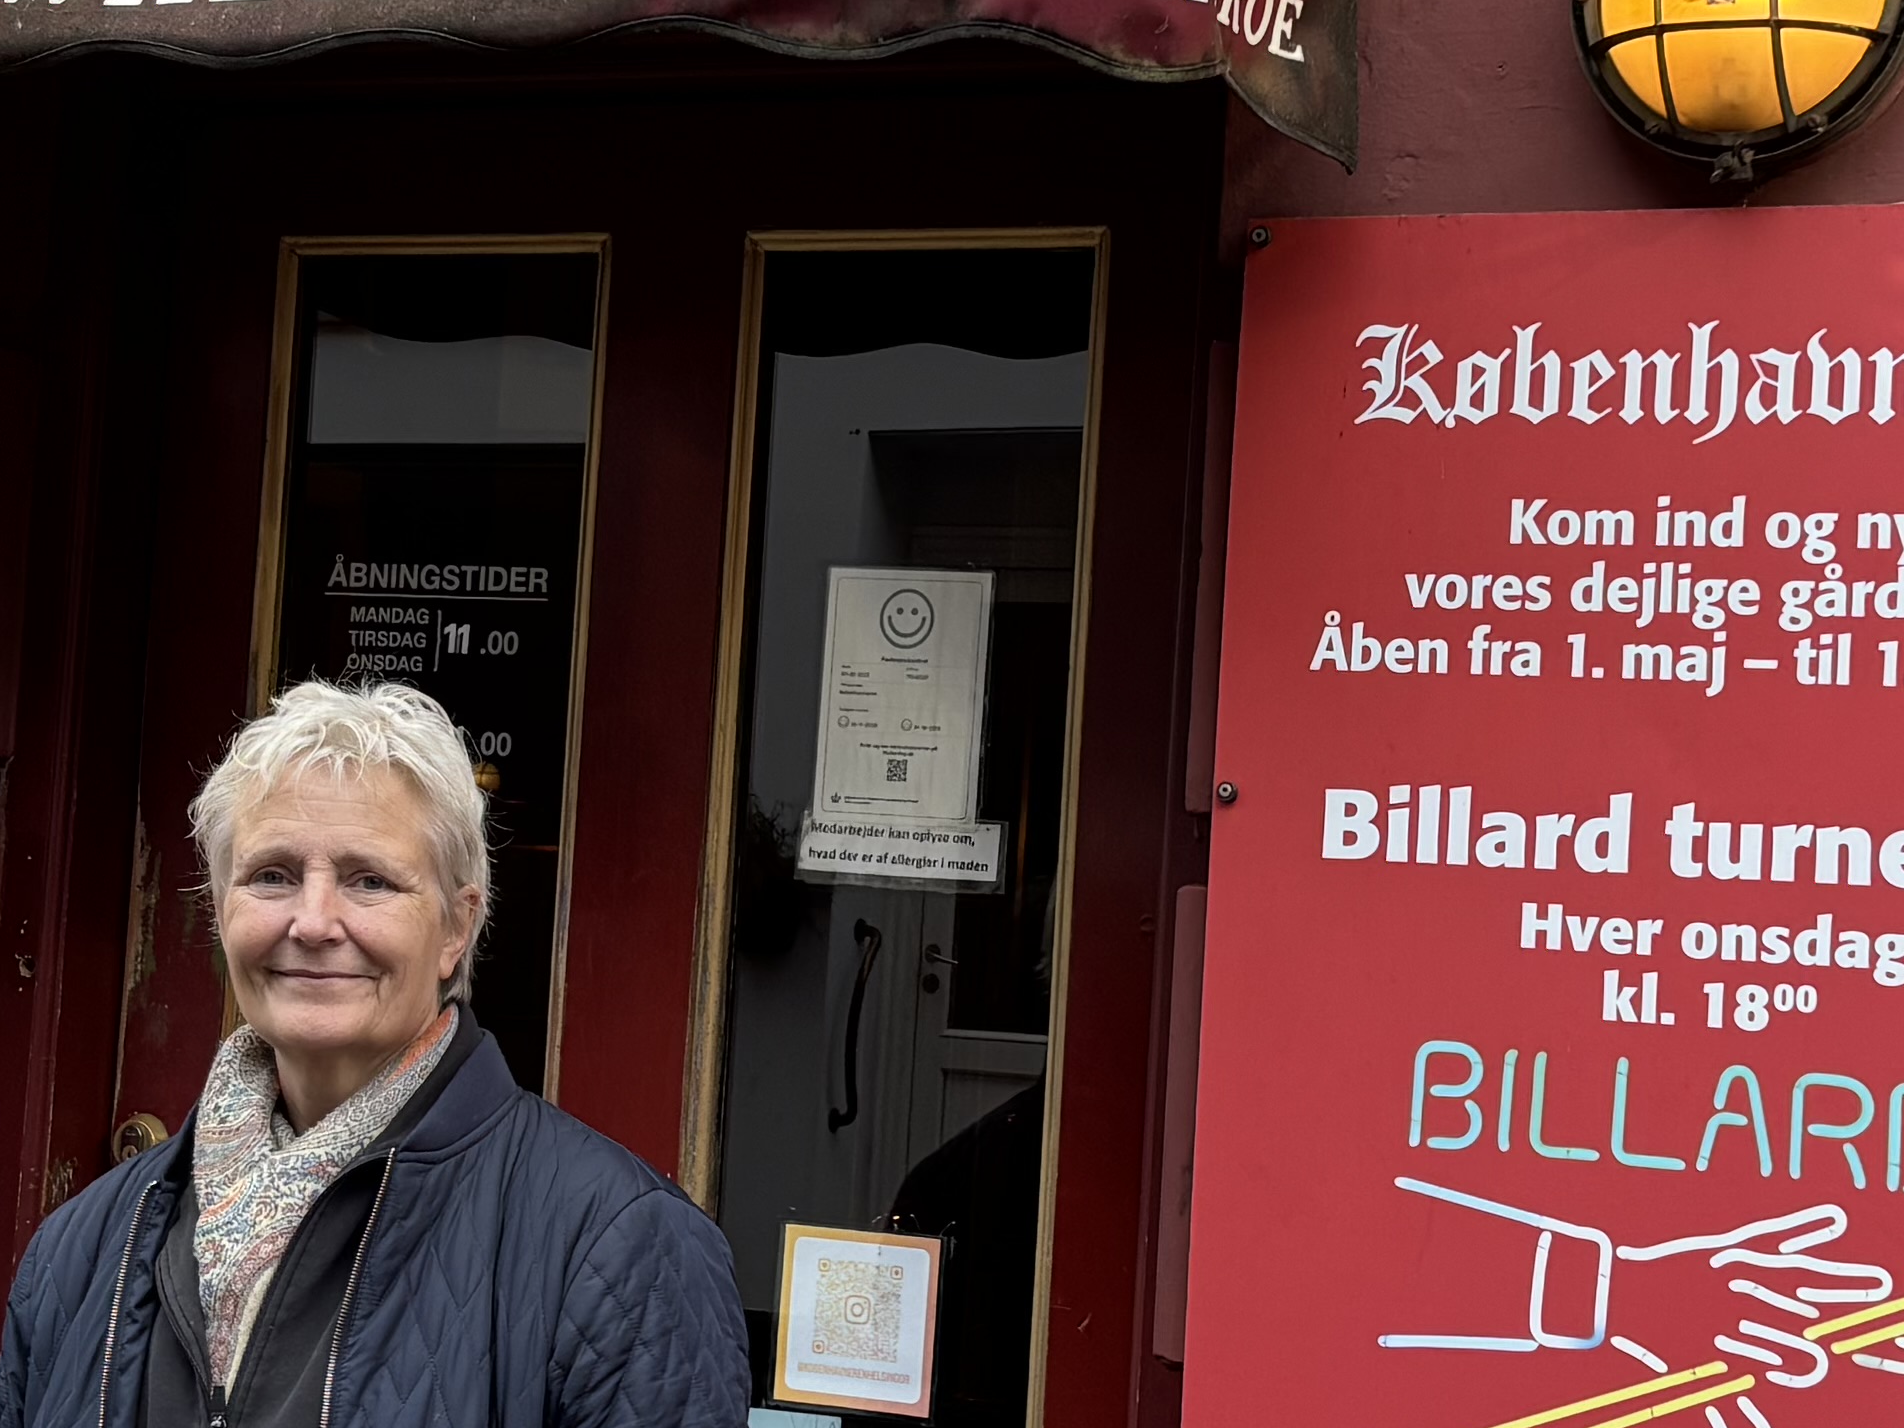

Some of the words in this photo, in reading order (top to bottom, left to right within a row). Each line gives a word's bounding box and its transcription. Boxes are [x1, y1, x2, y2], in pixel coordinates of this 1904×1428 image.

[1509, 498, 1634, 548] Kom
[1656, 495, 1745, 549] ind
[1765, 511, 1838, 563] og
[328, 554, 548, 592] ÅBNINGSTIDER
[1405, 571, 1551, 614] vores
[1570, 561, 1760, 629] dejlige
[351, 607, 429, 624] MANDAG
[347, 653, 423, 671] ONSDAG
[349, 630, 426, 648] TIRSDAG
[1310, 610, 1451, 676] Åben
[1468, 624, 1541, 677] fra
[1565, 636, 1606, 678] 1.
[1621, 632, 1726, 696] maj
[1794, 632, 1851, 687] til
[888, 828, 910, 839] kan
[953, 835, 975, 847] om,
[1320, 786, 1633, 874] Billard
[809, 847, 835, 860] hvad
[839, 849, 858, 861] der
[862, 854, 872, 862] er
[876, 853, 888, 863] af
[948, 860, 988, 872] maden
[1519, 901, 1662, 956] Hver
[1602, 970, 1674, 1026] kl.
